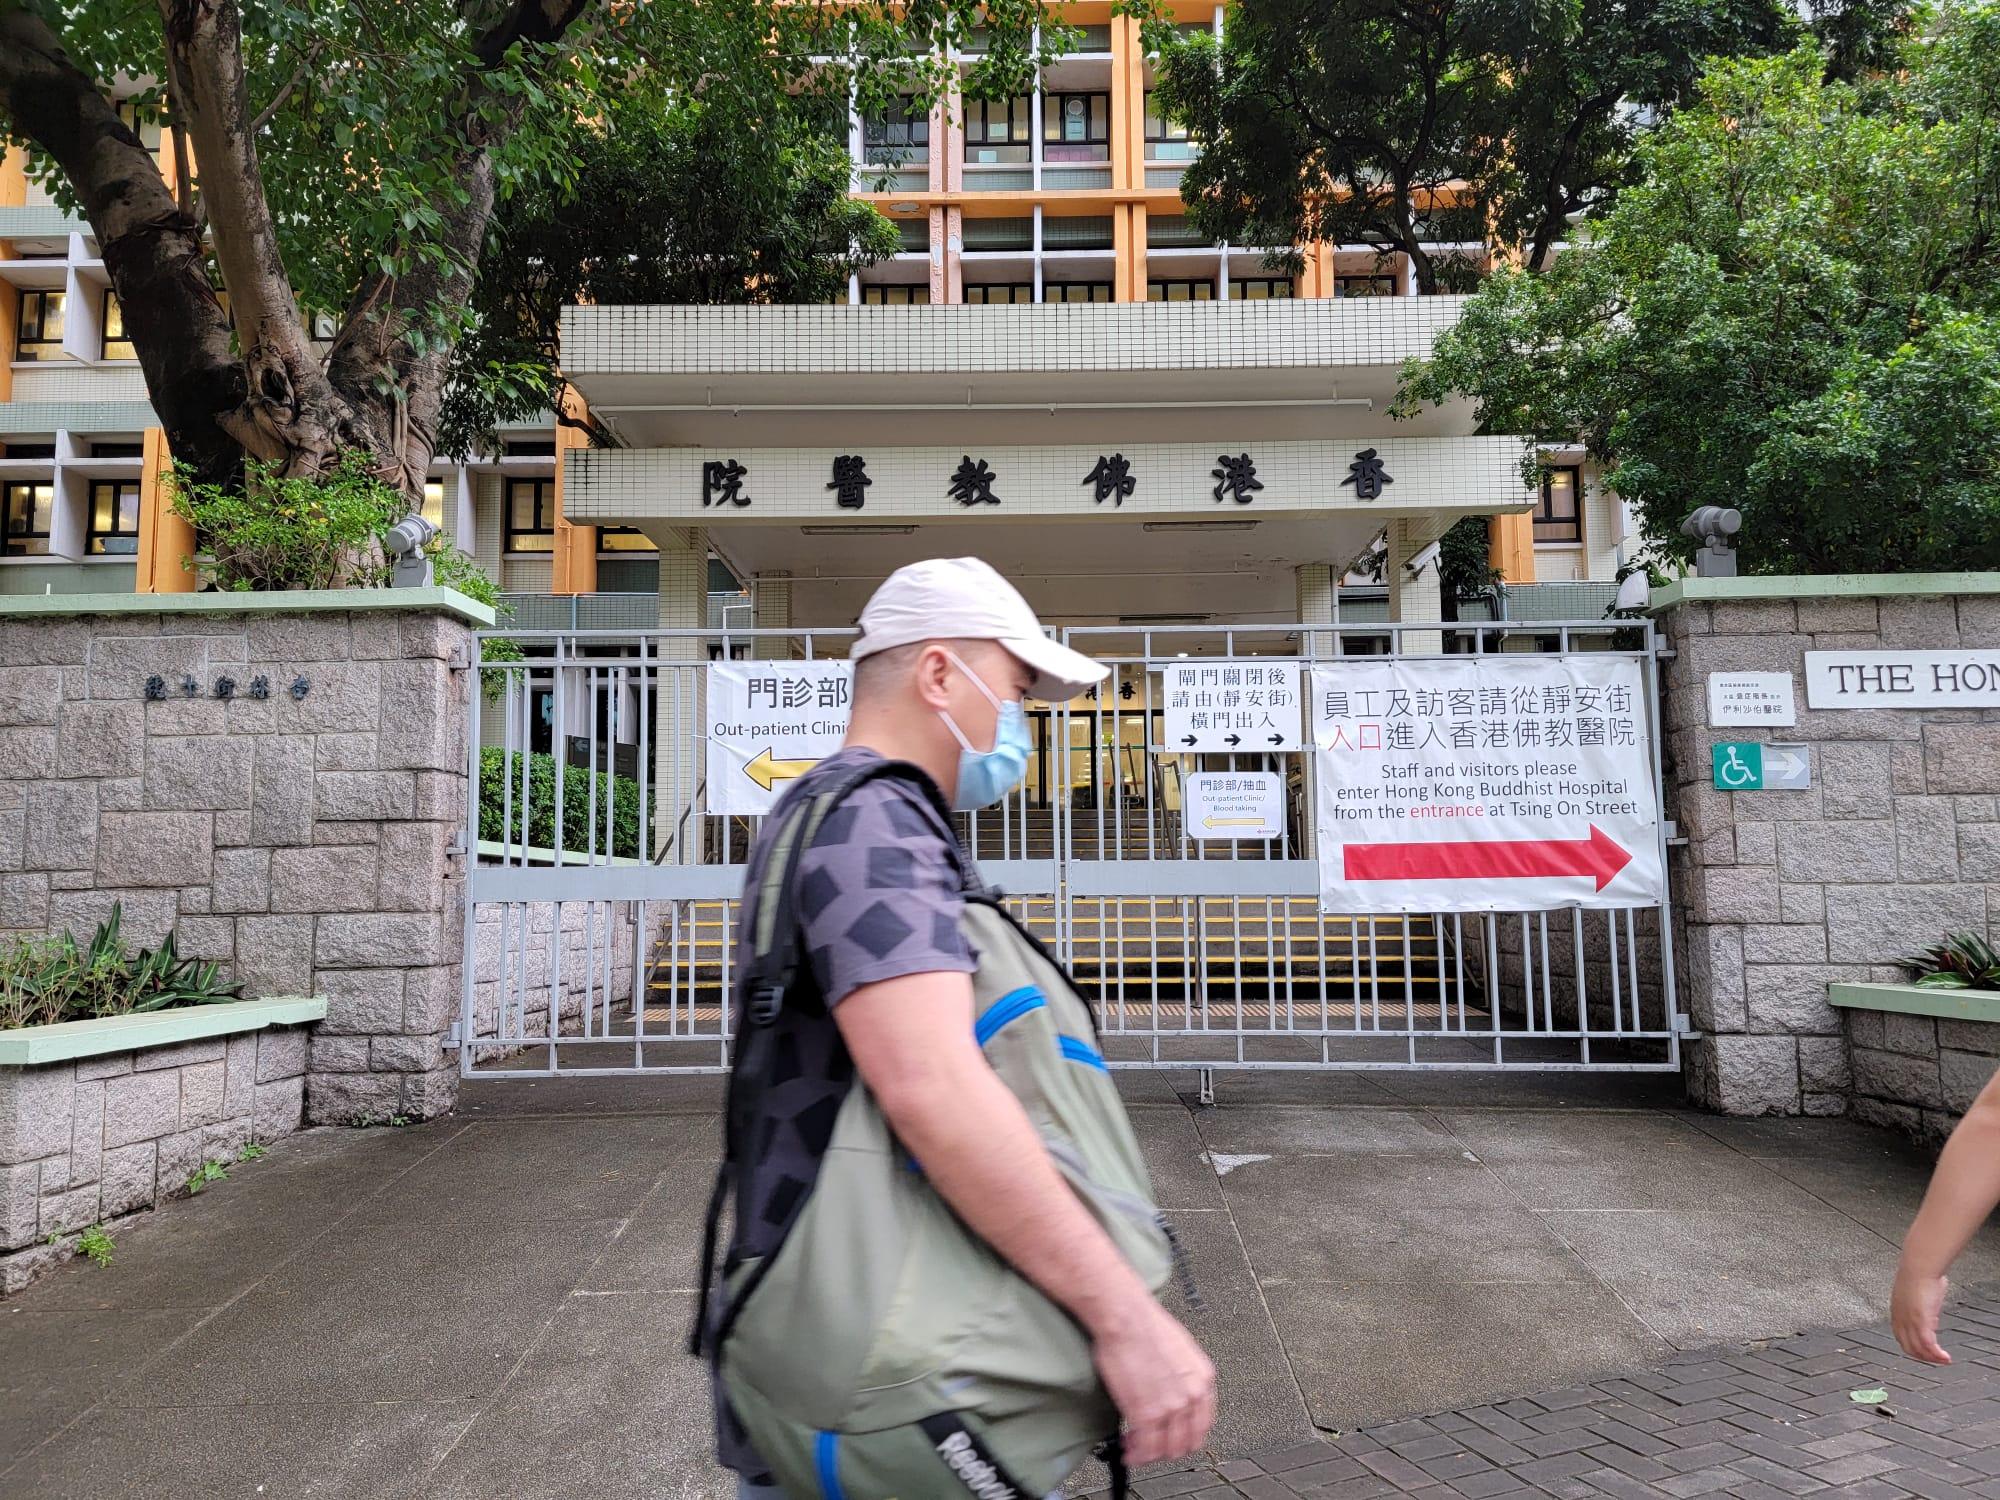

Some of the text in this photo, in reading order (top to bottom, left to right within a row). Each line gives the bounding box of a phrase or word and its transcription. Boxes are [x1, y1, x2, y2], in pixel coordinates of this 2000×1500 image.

[702, 448, 1393, 509] 香港佛教醫院
[1179, 668, 1285, 686] 閘門關閉後
[1829, 665, 1914, 693] THE
[748, 677, 853, 709] 門診部
[1171, 690, 1293, 708] 請由(靜安街)
[1324, 684, 1632, 720] 員工及訪客請從靜安街
[714, 721, 807, 739] Out-patient
[1190, 712, 1275, 730] 橫門出入
[1328, 717, 1635, 752] 入口進入香港佛教醫院
[1381, 760, 1577, 780] Staff and visitors please
[1201, 780, 1266, 792] 門診部/抽血
[1337, 779, 1628, 801] enter Hong Kong Buddhist Hospital
[1213, 804, 1257, 813] Blood taking
[1334, 799, 1638, 820] from the entrance at Tsing On Street
